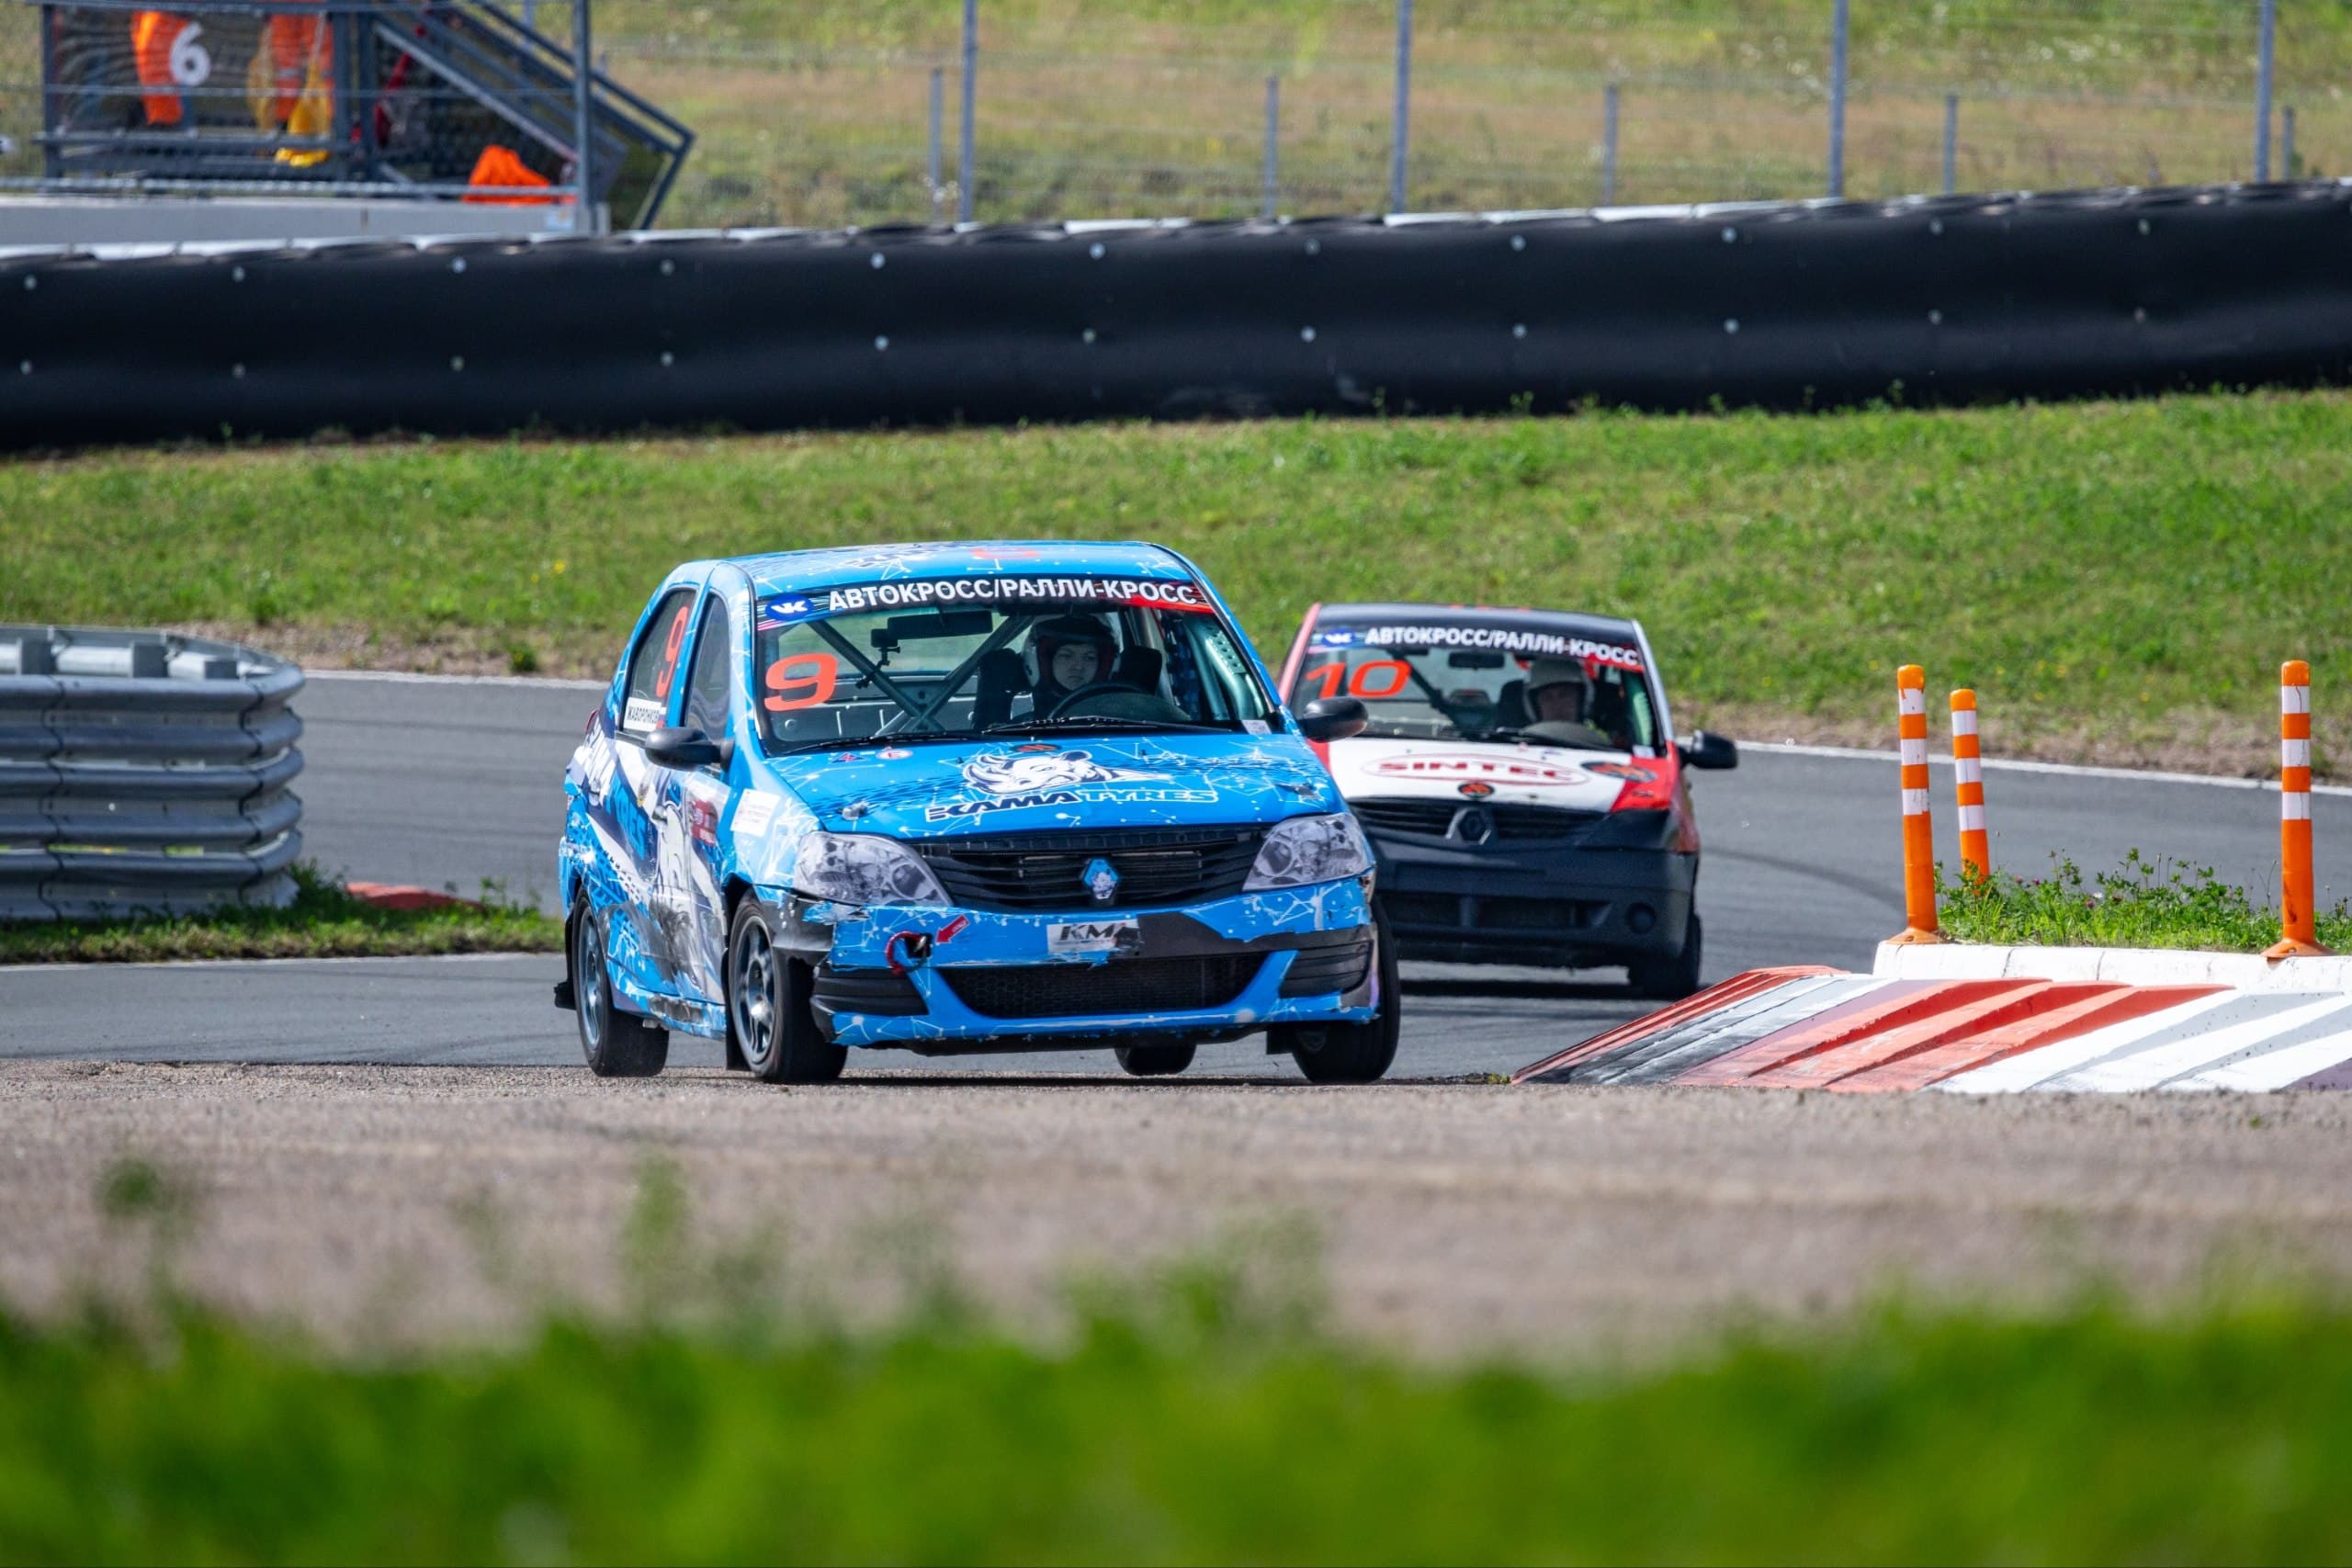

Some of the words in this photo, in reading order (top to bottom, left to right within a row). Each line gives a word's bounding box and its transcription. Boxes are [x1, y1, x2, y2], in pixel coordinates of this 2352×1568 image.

[169, 22, 211, 86] 6
[829, 579, 1197, 611] АВТОКРОСС/РАЛЛИ-КРОСС
[657, 606, 688, 696] 9
[1364, 626, 1638, 665] АВТОКРОСС/РАЛЛИ-КРОСС
[764, 653, 838, 711] 9
[1306, 660, 1412, 699] 10
[1379, 761, 1574, 781] SINTEC
[1078, 789, 1218, 804] TYRES
